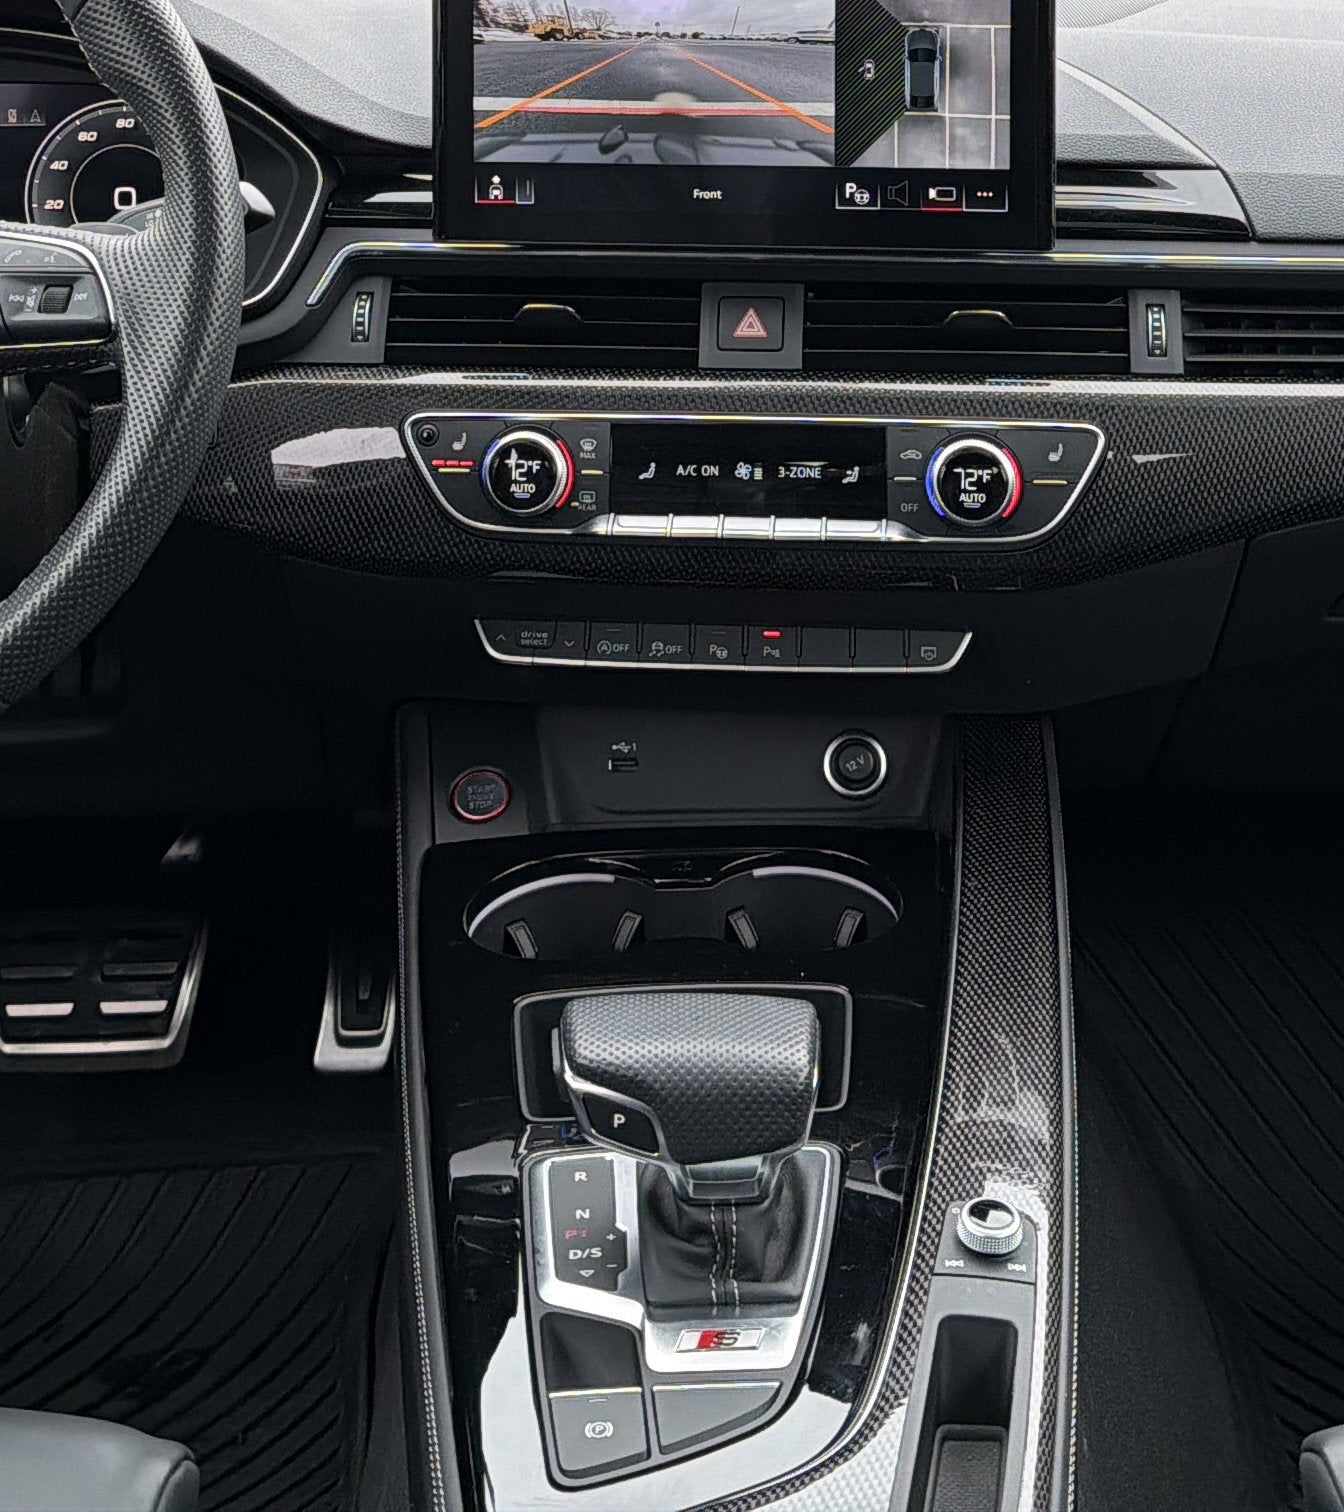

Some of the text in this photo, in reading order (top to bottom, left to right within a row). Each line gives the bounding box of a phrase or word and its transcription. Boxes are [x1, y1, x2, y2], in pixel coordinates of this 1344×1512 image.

[115, 118, 135, 128] 80
[49, 160, 69, 170] 40
[693, 189, 723, 200] Front
[44, 199, 65, 210] 20
[579, 451, 597, 460] MAX
[675, 464, 719, 477] A/C ON
[777, 466, 822, 479] 3-ZONE
[509, 483, 536, 493] AUTO
[958, 493, 987, 503] AUTO
[900, 503, 920, 513] OFF
[520, 630, 549, 639] drive
[520, 637, 548, 646] select
[612, 643, 631, 653] OFF
[665, 645, 683, 655] OFF
[613, 1113, 626, 1129] P
[574, 1171, 588, 1182] R
[575, 1208, 590, 1220] N
[568, 1247, 603, 1260] D/S
